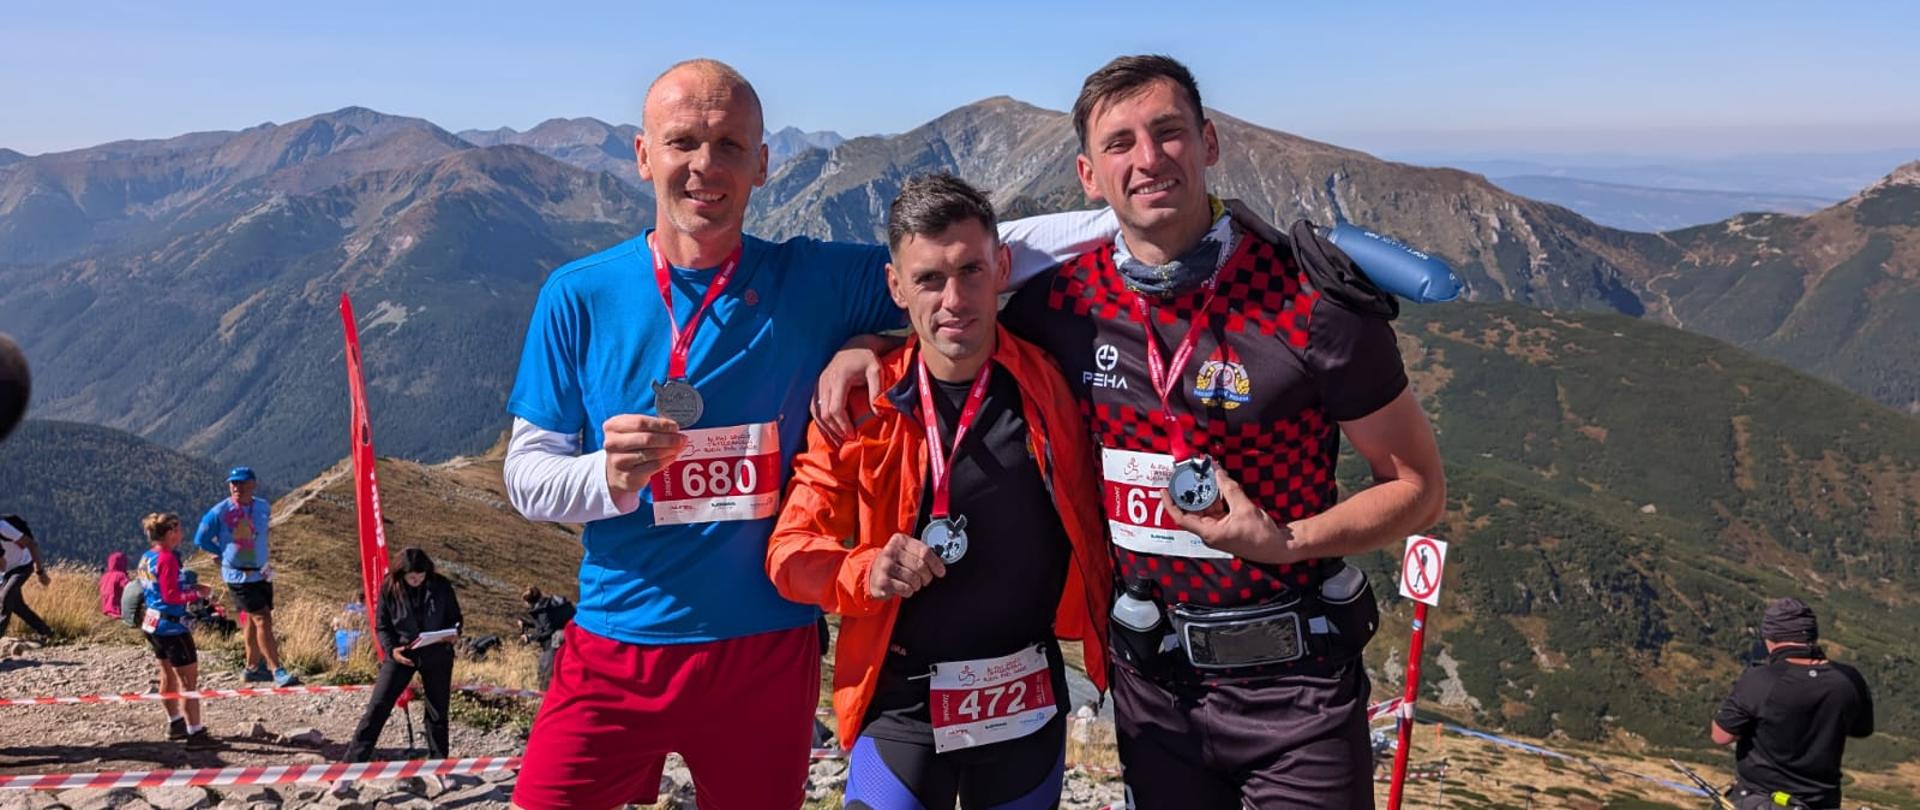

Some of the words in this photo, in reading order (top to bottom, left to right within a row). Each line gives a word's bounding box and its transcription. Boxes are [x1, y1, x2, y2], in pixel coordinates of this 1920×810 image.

[1082, 370, 1128, 390] PEHA
[682, 458, 757, 497] 680
[1127, 487, 1165, 527] 67
[958, 680, 1027, 721] 472
